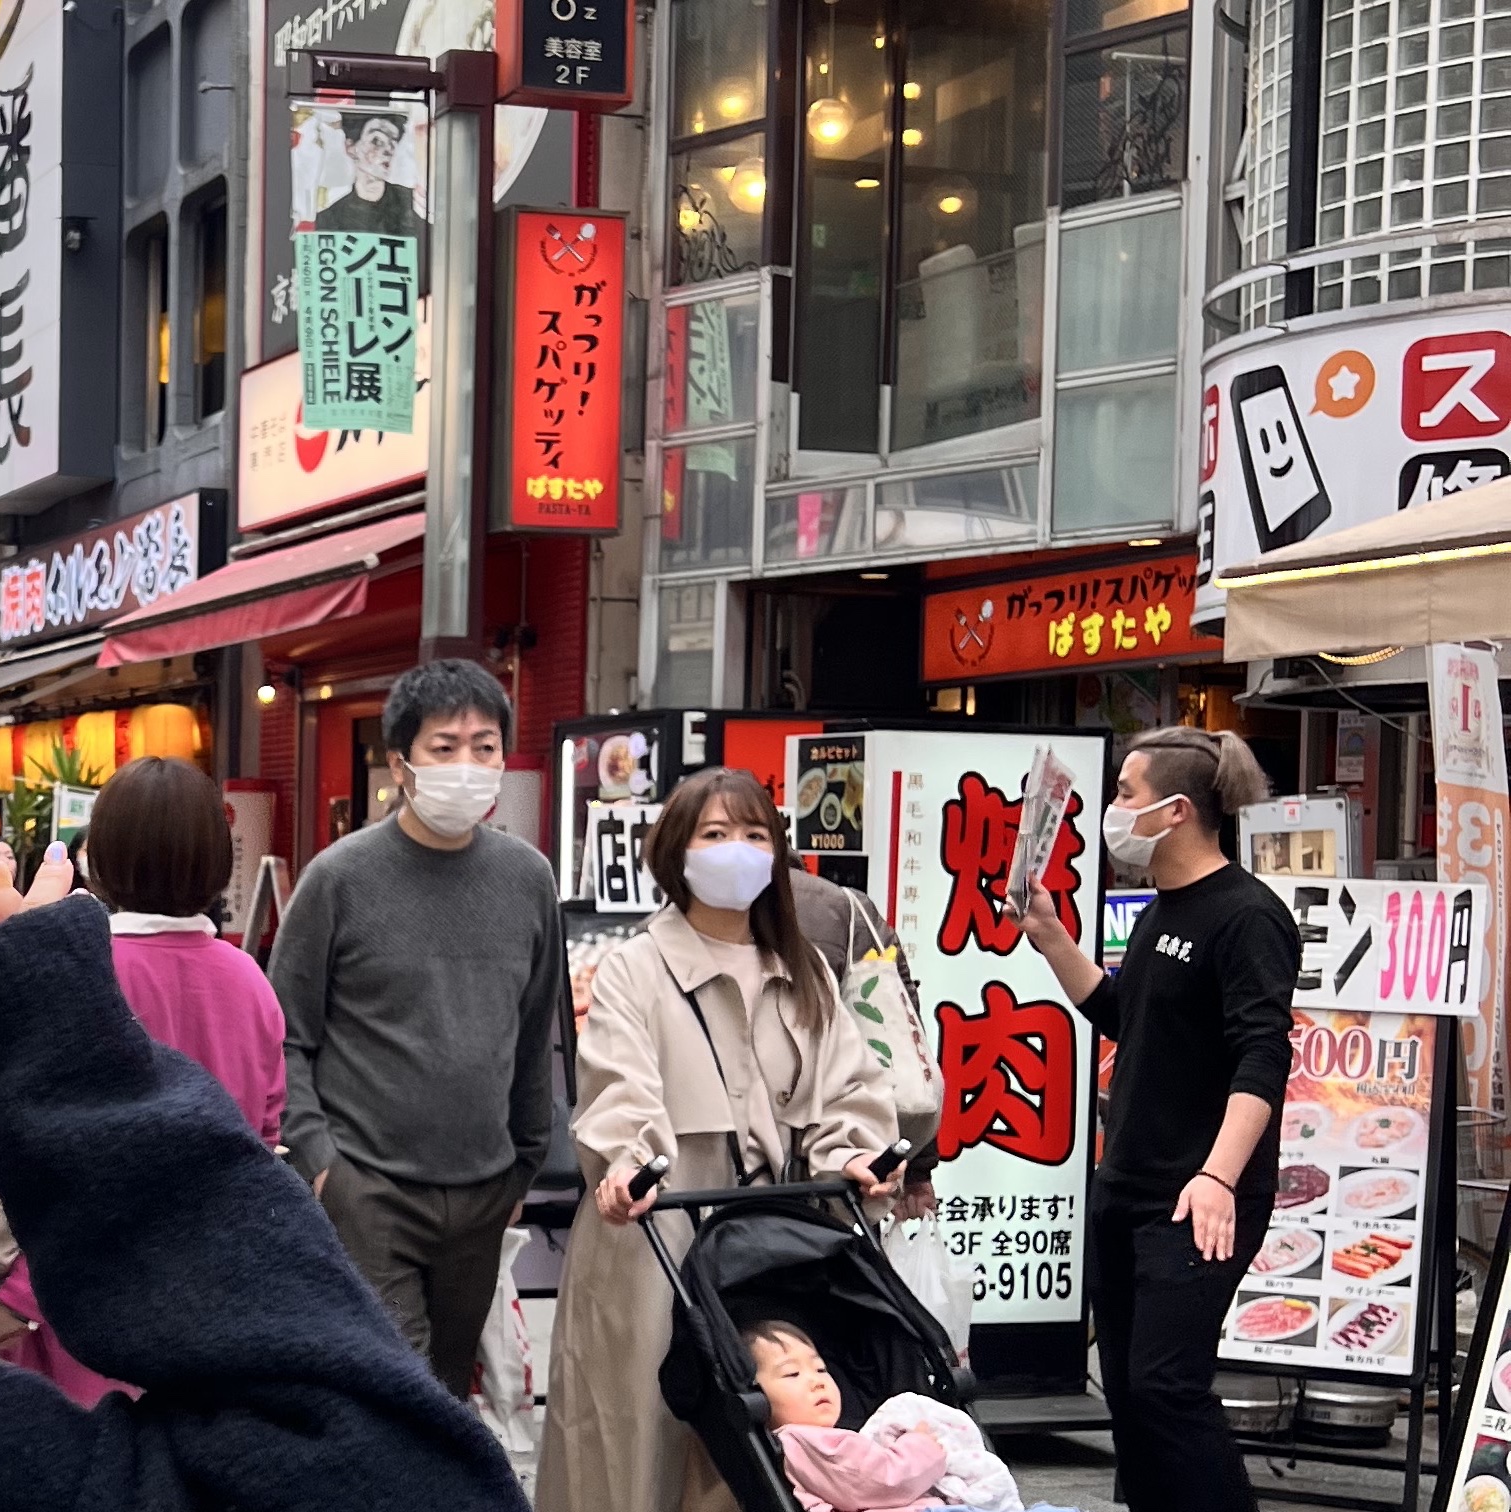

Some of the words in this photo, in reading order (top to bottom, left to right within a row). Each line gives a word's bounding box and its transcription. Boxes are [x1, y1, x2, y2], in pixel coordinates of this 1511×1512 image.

[544, 37, 603, 62] 美容室
[555, 64, 591, 86] 2F
[318, 234, 338, 303] EGON
[341, 234, 383, 405] シーレ展
[320, 308, 342, 405] SCHIELE
[533, 310, 567, 470] スパゲッティ
[526, 474, 604, 501] ぱすたや
[1048, 602, 1173, 659] ぱすたや
[936, 1194, 1075, 1223] 会承ります!
[991, 1229, 1073, 1257] 全90席
